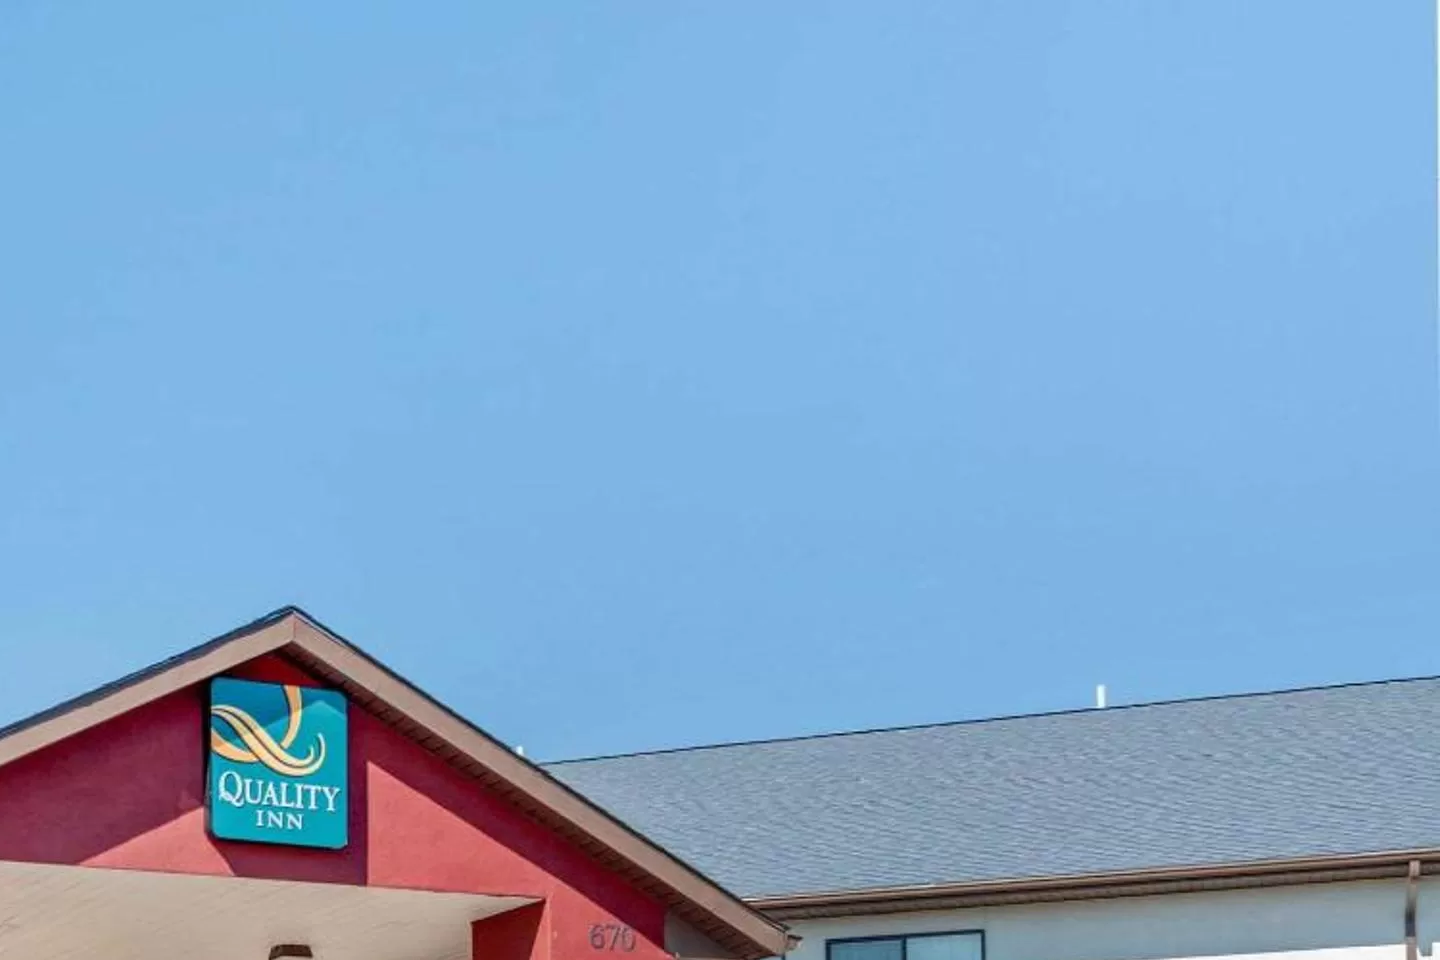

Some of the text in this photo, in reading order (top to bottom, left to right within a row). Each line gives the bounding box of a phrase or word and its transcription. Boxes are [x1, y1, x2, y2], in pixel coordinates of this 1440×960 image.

[218, 770, 341, 812] QUALITY
[255, 809, 304, 830] INN
[588, 924, 637, 953] 670
